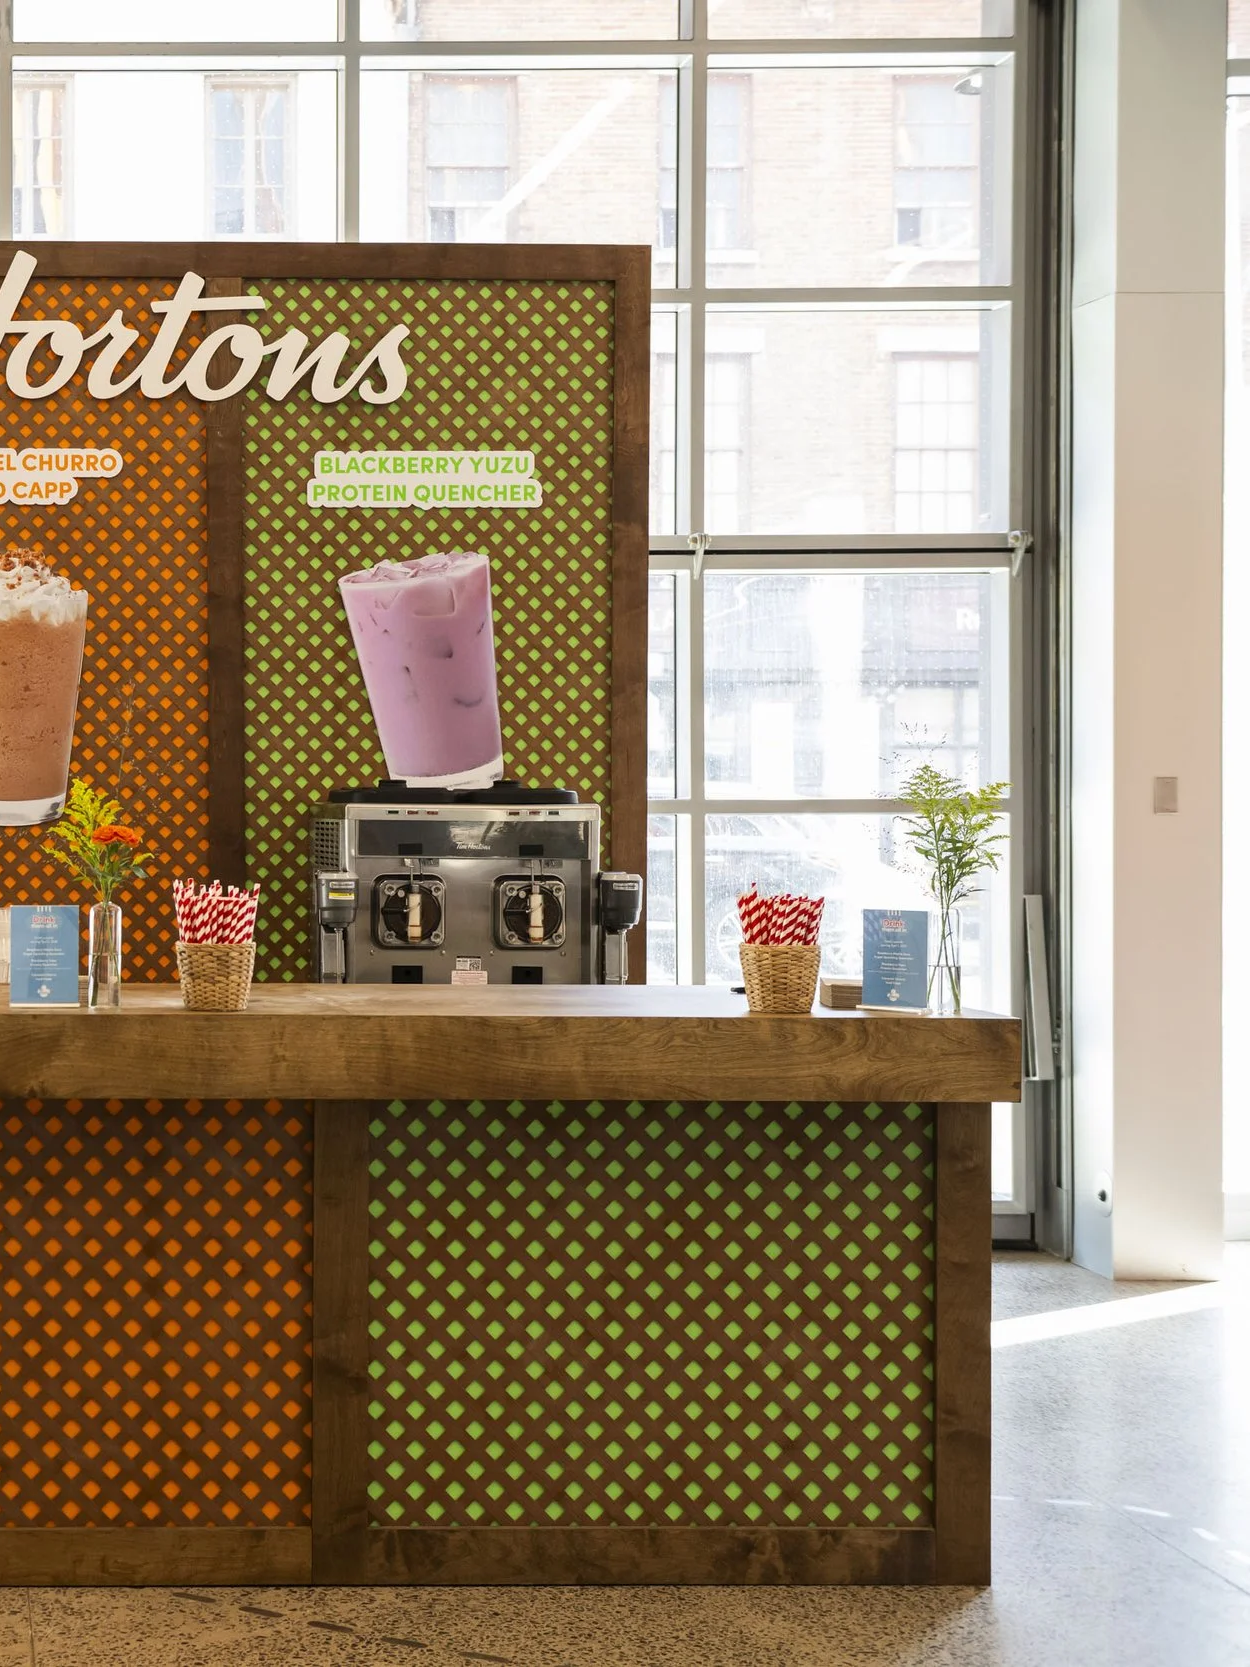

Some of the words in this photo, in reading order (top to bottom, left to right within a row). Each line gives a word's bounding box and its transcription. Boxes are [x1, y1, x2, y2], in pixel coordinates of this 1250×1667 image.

[21, 453, 117, 472] CHURRO
[320, 457, 463, 474] BLACKBERRY
[469, 457, 529, 474] YUZU
[11, 481, 73, 499] CAPP
[313, 484, 407, 502] PROTEIN
[413, 484, 536, 504] QUENCHER
